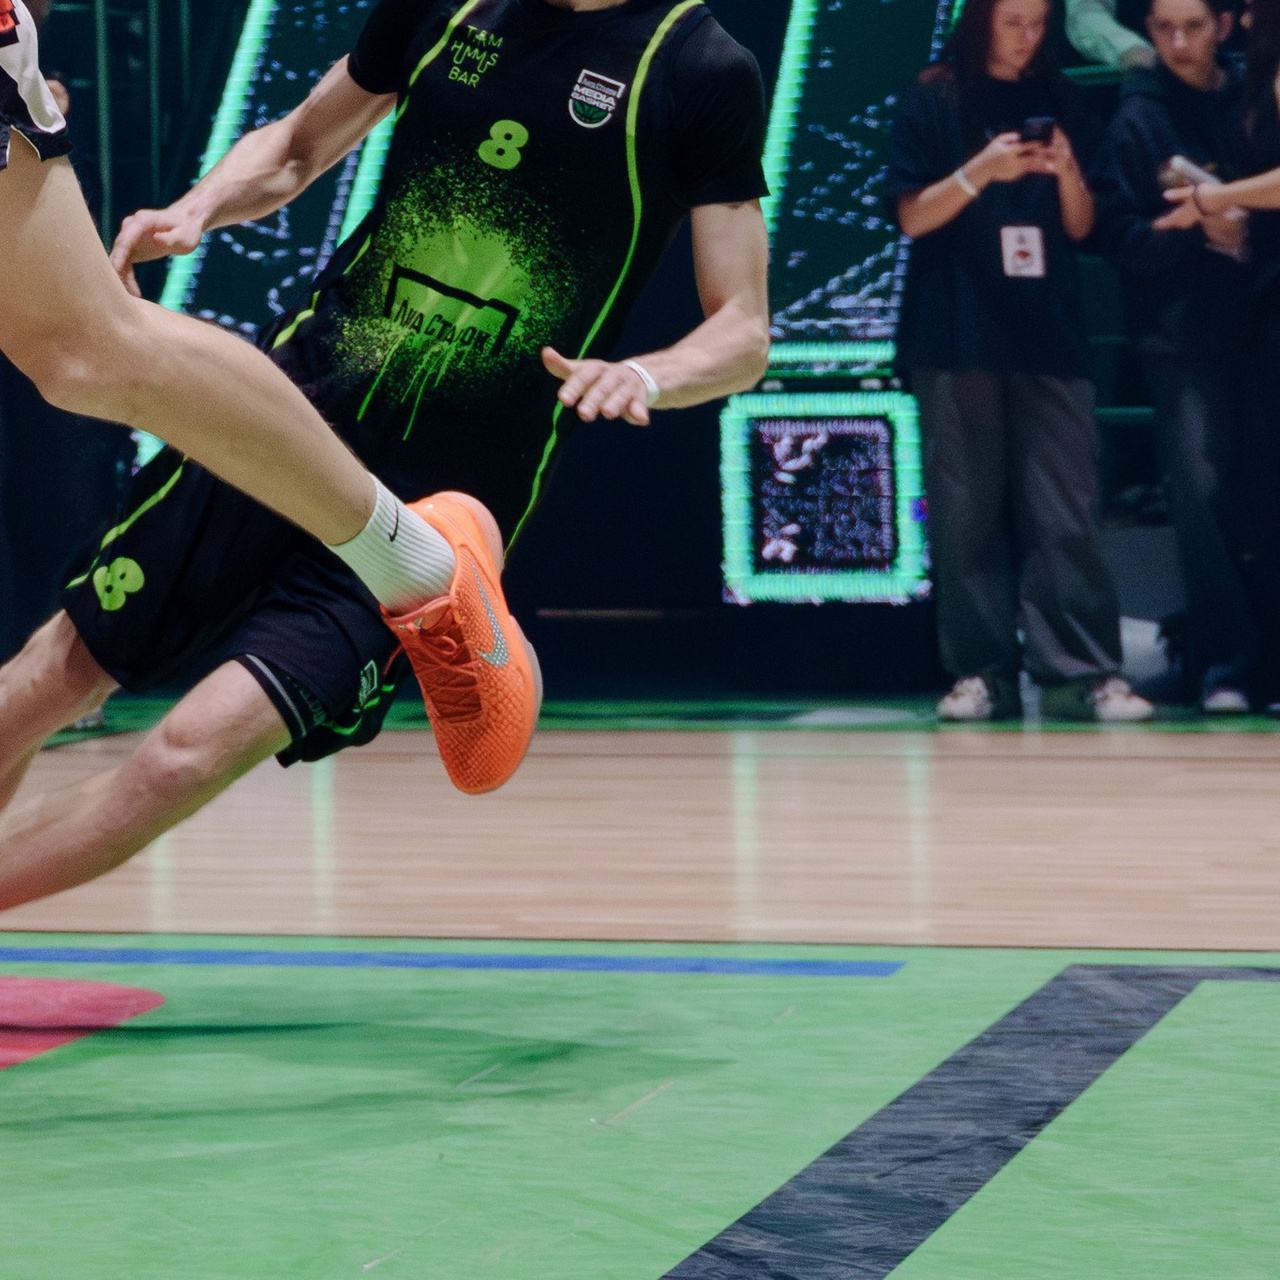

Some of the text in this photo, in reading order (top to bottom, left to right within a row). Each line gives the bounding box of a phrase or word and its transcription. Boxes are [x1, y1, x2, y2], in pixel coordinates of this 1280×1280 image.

[448, 66, 480, 88] BAR
[570, 91, 615, 112] BASKET
[573, 84, 616, 106] MEDIA
[477, 119, 529, 170] 8
[93, 556, 145, 611] 8
